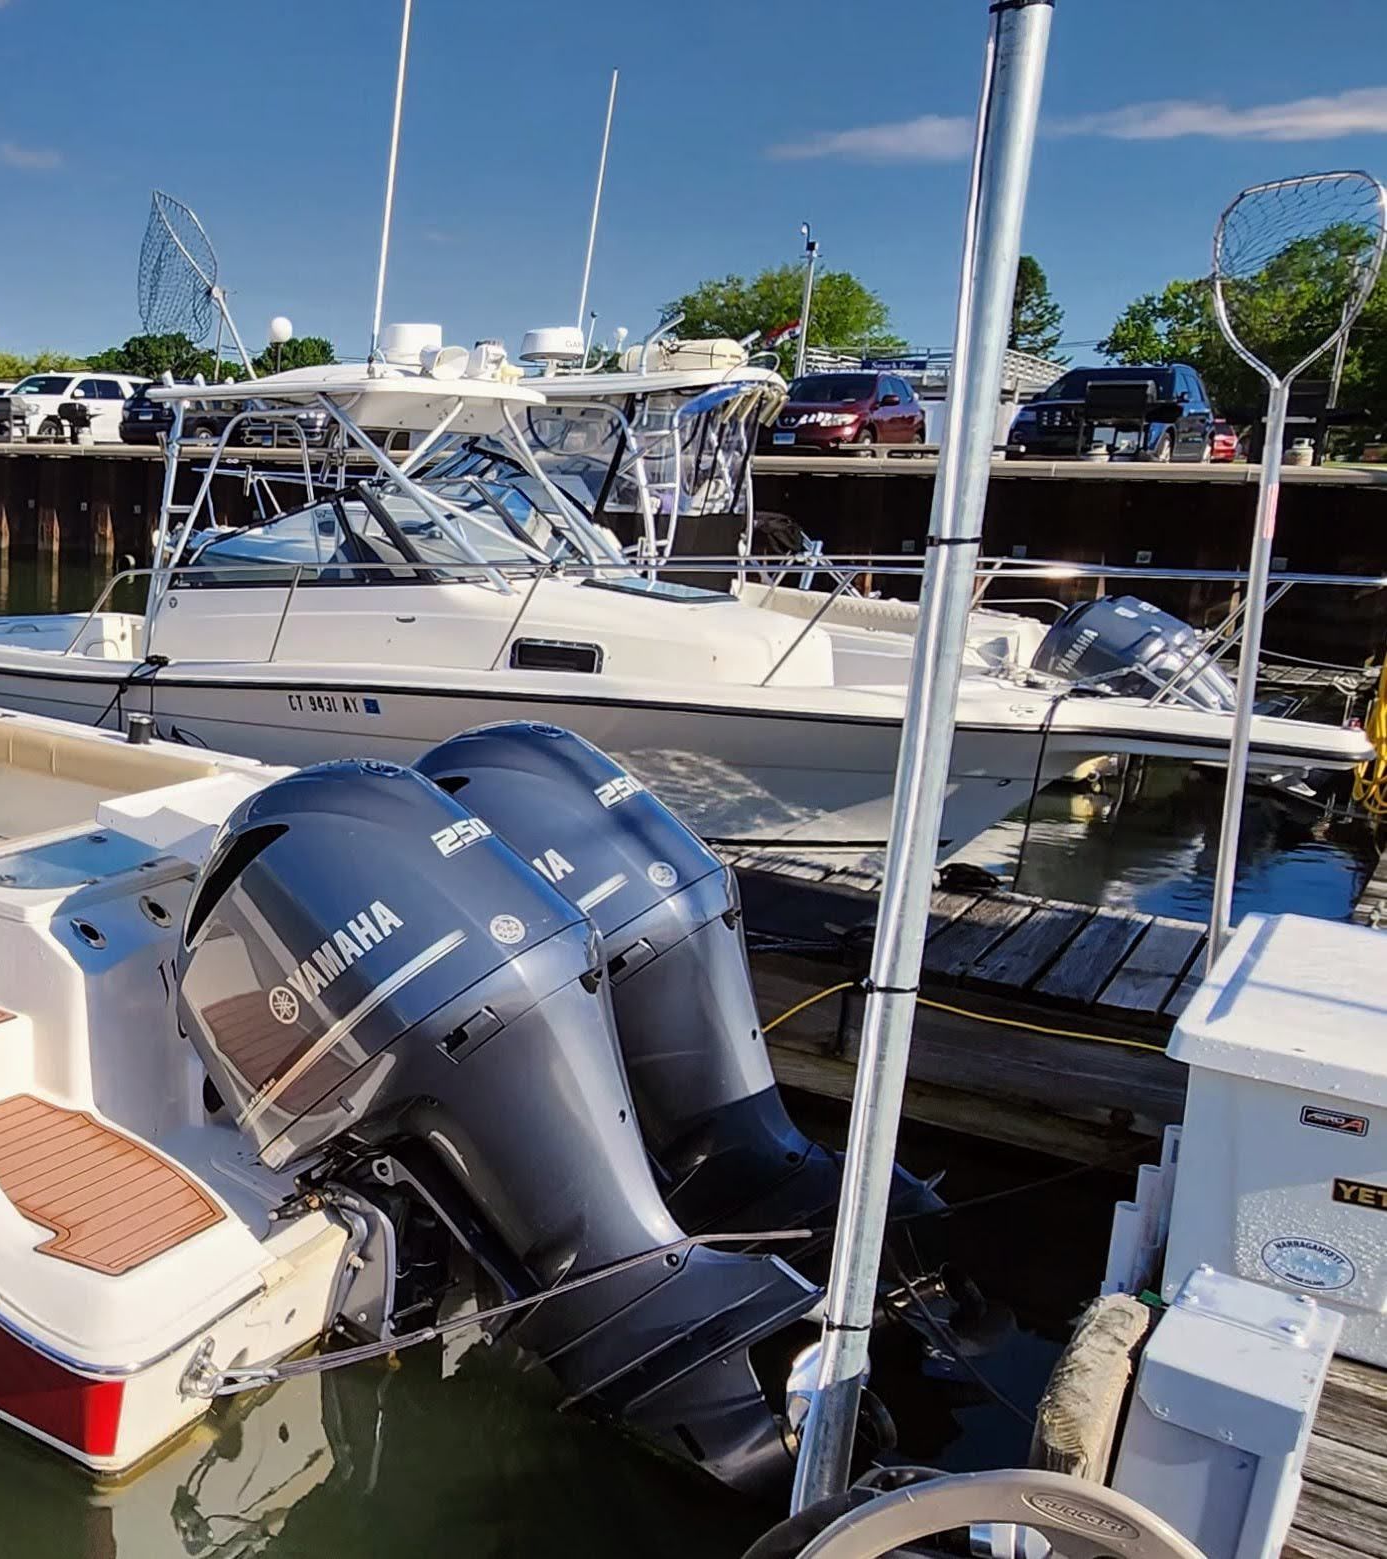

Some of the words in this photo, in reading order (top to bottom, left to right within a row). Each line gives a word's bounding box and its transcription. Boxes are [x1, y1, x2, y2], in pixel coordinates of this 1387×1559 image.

[1055, 628, 1099, 674] YAMAHA
[287, 694, 303, 711] CT
[308, 695, 338, 713] 9431
[342, 695, 359, 713] AY
[593, 774, 645, 809] 250
[430, 817, 493, 857] 250
[285, 900, 405, 1003] YAMAHA
[1272, 1240, 1346, 1265] NARRAGANSETT
